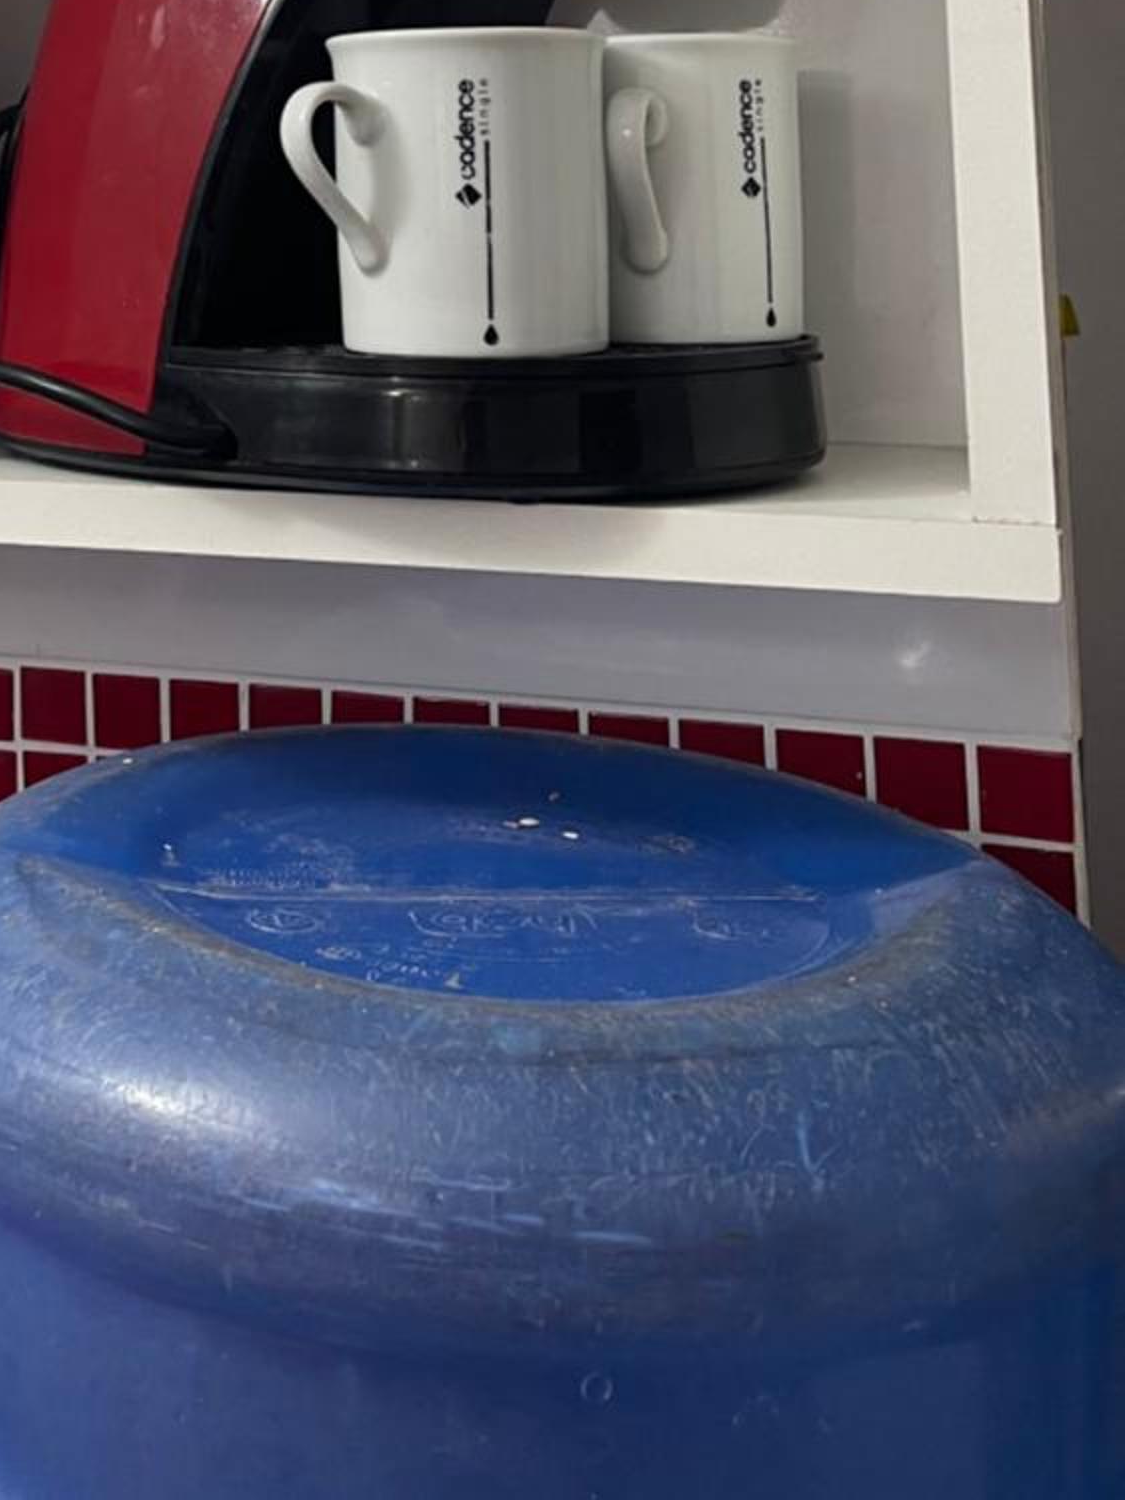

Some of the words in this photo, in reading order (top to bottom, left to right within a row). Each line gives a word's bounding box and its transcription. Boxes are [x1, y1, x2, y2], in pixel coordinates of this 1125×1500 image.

[453, 78, 476, 180] cadence
[478, 79, 492, 136] single
[738, 79, 757, 174] cadence
